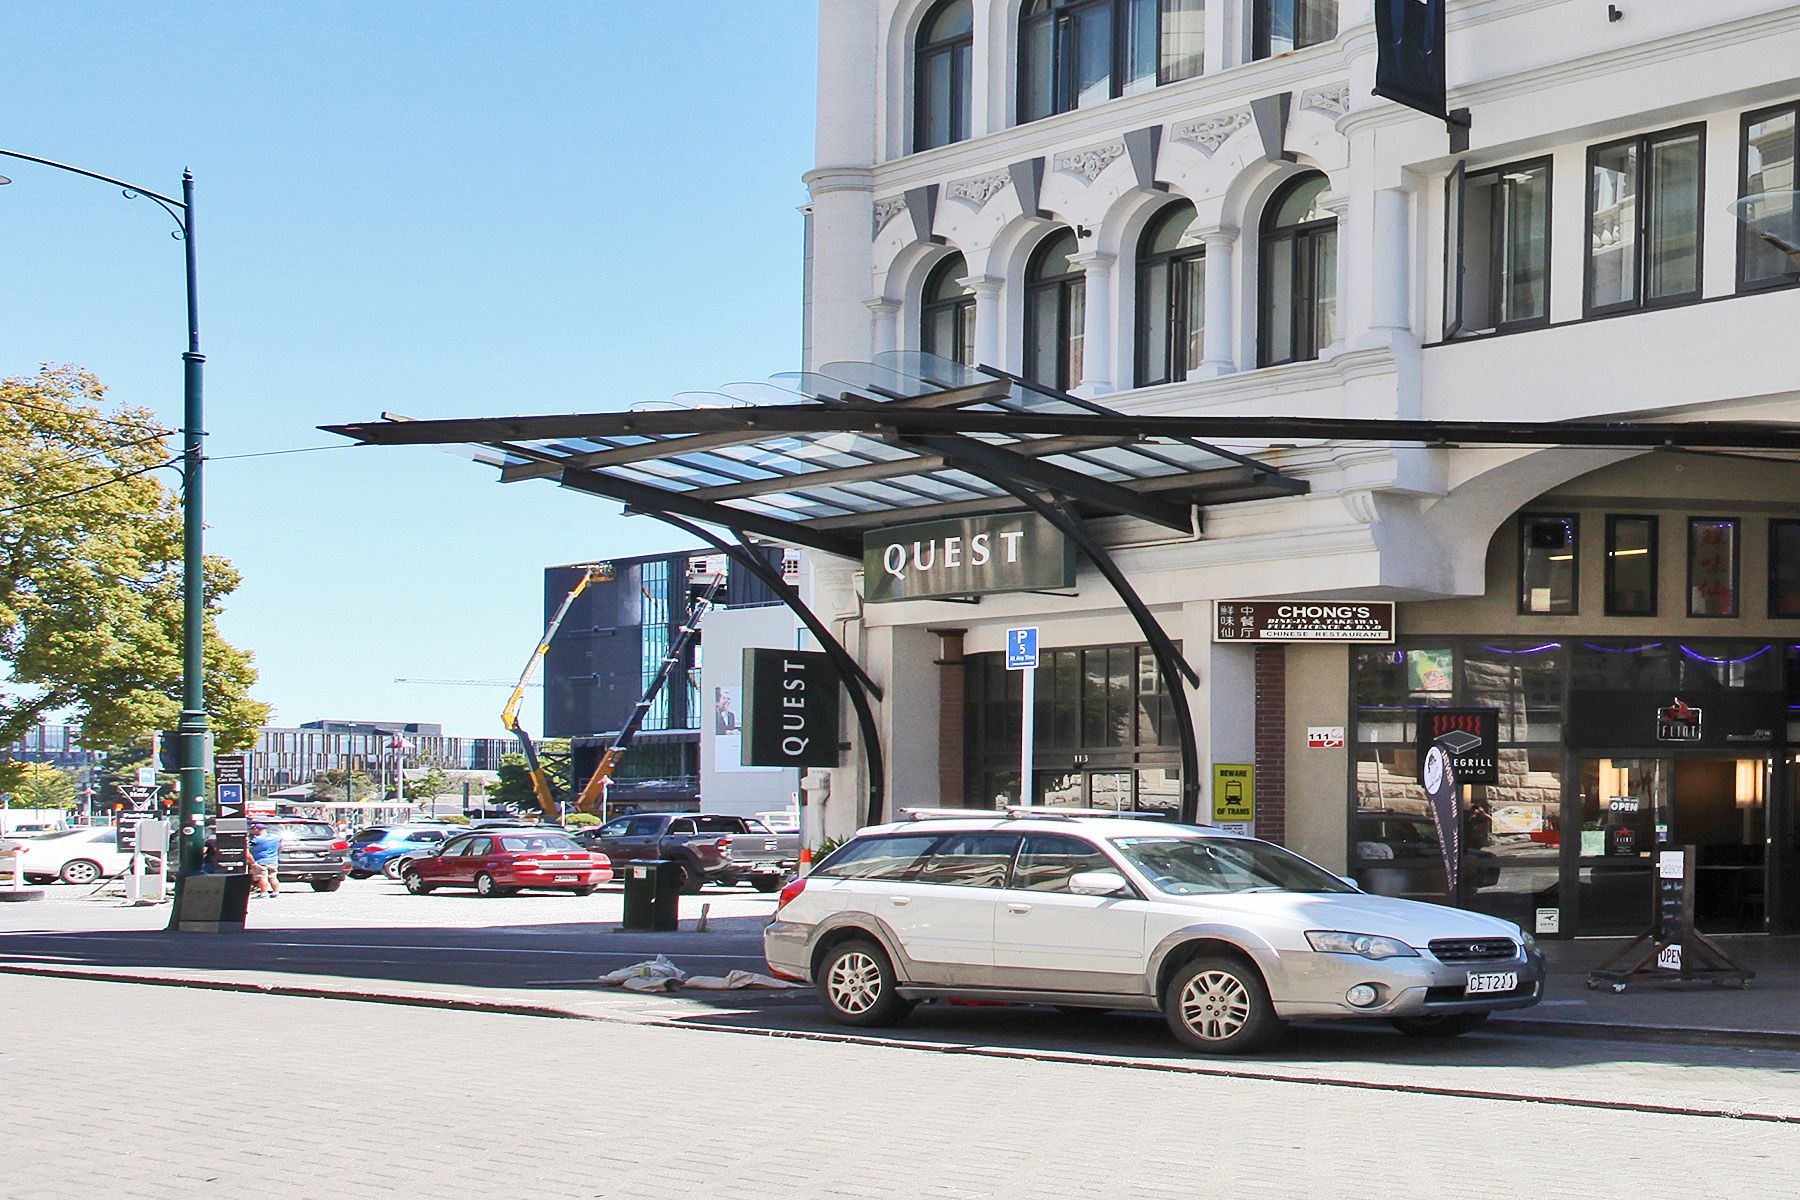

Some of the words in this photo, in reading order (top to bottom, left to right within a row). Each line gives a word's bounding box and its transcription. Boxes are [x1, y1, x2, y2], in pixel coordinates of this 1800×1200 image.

[883, 531, 1024, 580] QUEST
[1277, 606, 1371, 618] CHONG'S
[1017, 630, 1028, 644] P
[1020, 644, 1026, 655] 5
[782, 660, 809, 756] QUEST
[1662, 725, 1697, 737] FLINT
[1074, 755, 1089, 763] 113
[1610, 801, 1638, 812] OPEN
[1660, 948, 1681, 964] OPEN
